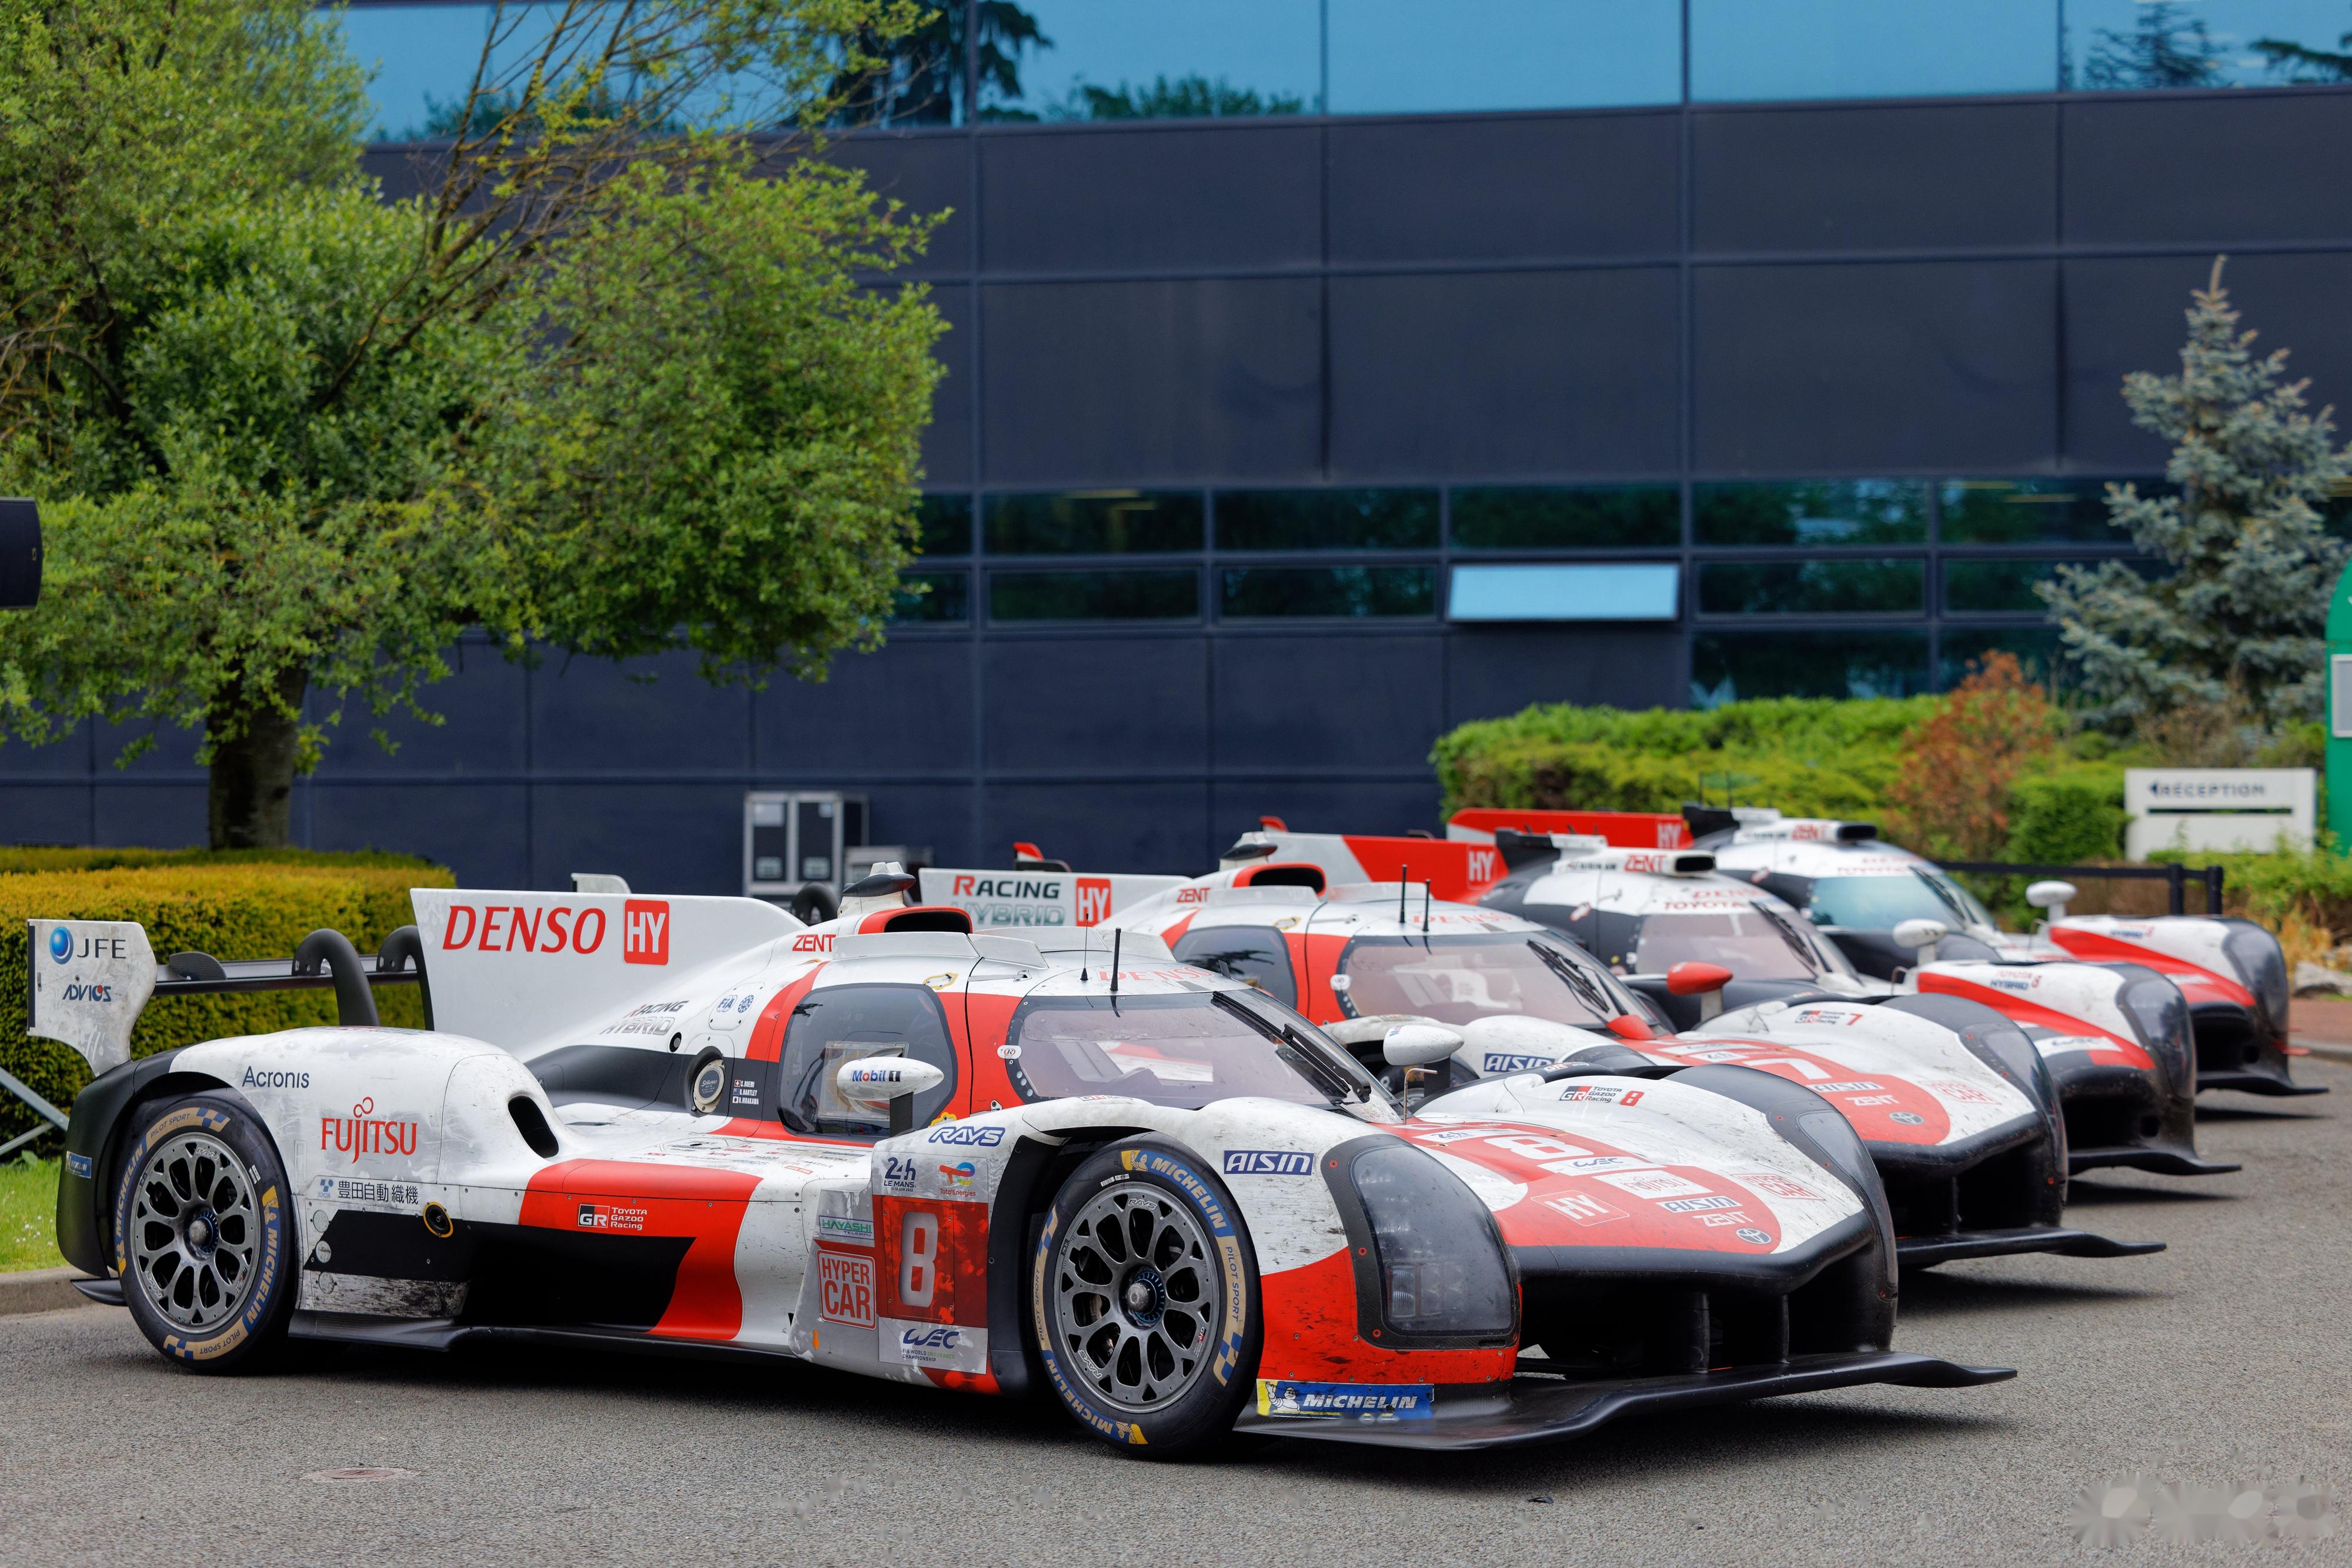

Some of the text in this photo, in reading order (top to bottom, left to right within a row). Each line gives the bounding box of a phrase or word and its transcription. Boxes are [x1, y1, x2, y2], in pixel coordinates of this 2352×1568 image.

[2160, 783, 2264, 797] RECEPTION
[1658, 823, 1682, 848] HY
[1469, 850, 1495, 882] HY
[1624, 854, 1669, 873] ZENT
[953, 875, 1061, 899] RACING
[1177, 887, 1211, 903] ZENT
[1077, 887, 1109, 923] HY
[442, 905, 666, 955] DENSO HY
[77, 938, 126, 959] JFE
[792, 934, 837, 952] ZENT
[62, 984, 112, 1002] ADVICS
[623, 1000, 689, 1017] RACING
[718, 998, 734, 1009] FIA
[599, 1017, 676, 1036] HYBRID
[1847, 1012, 1863, 1026] 7
[242, 1065, 310, 1088] Acronis
[852, 1070, 887, 1082] Mobil
[1543, 1062, 1566, 1073] GR
[1743, 1058, 1832, 1080] 7
[1814, 1082, 1880, 1092] AISIN
[1560, 1091, 1586, 1101] GR
[1619, 1090, 1645, 1106] 8
[1845, 1095, 1900, 1106] ZENT
[151, 1113, 191, 1139] PILOT SPORT
[929, 1126, 1005, 1146] RAYS
[320, 1118, 418, 1164] FUJITSU
[1483, 1135, 1594, 1160] 8
[196, 1147, 219, 1161] RAYS
[1225, 1153, 1311, 1173] AISIN
[1573, 1158, 1624, 1168] WEC
[884, 1157, 917, 1181] 24h
[116, 1142, 143, 1237] MICHELIN
[338, 1181, 419, 1205] 豊田自動織機
[940, 1188, 976, 1198] TotalEnergies
[1151, 1156, 1228, 1229] MICHELIN
[1759, 1183, 1820, 1197] CAR
[1128, 1199, 1157, 1210] RAYS
[1545, 1194, 1610, 1221] HY
[1665, 1196, 1737, 1212] AISIN
[580, 1207, 647, 1226] GR TOYOTA
[610, 1221, 643, 1231] Racing
[821, 1219, 873, 1233] HAYASHI
[1692, 1211, 1754, 1227] ZENT
[898, 1211, 938, 1308] 8
[246, 1228, 278, 1325] MICHELIN
[821, 1258, 870, 1286] HYPER
[1225, 1245, 1240, 1322] PILOT SPORT
[824, 1280, 871, 1321] CAR
[1034, 1310, 1045, 1341] PILOT
[199, 1328, 240, 1355] PILOT SPORT
[903, 1328, 960, 1349] WEC
[927, 1351, 956, 1359] ENDURANCE
[1078, 1349, 1103, 1379] RAYS
[1045, 1358, 1114, 1435] MICHELIN
[1303, 1394, 1418, 1409] MICHELIN
